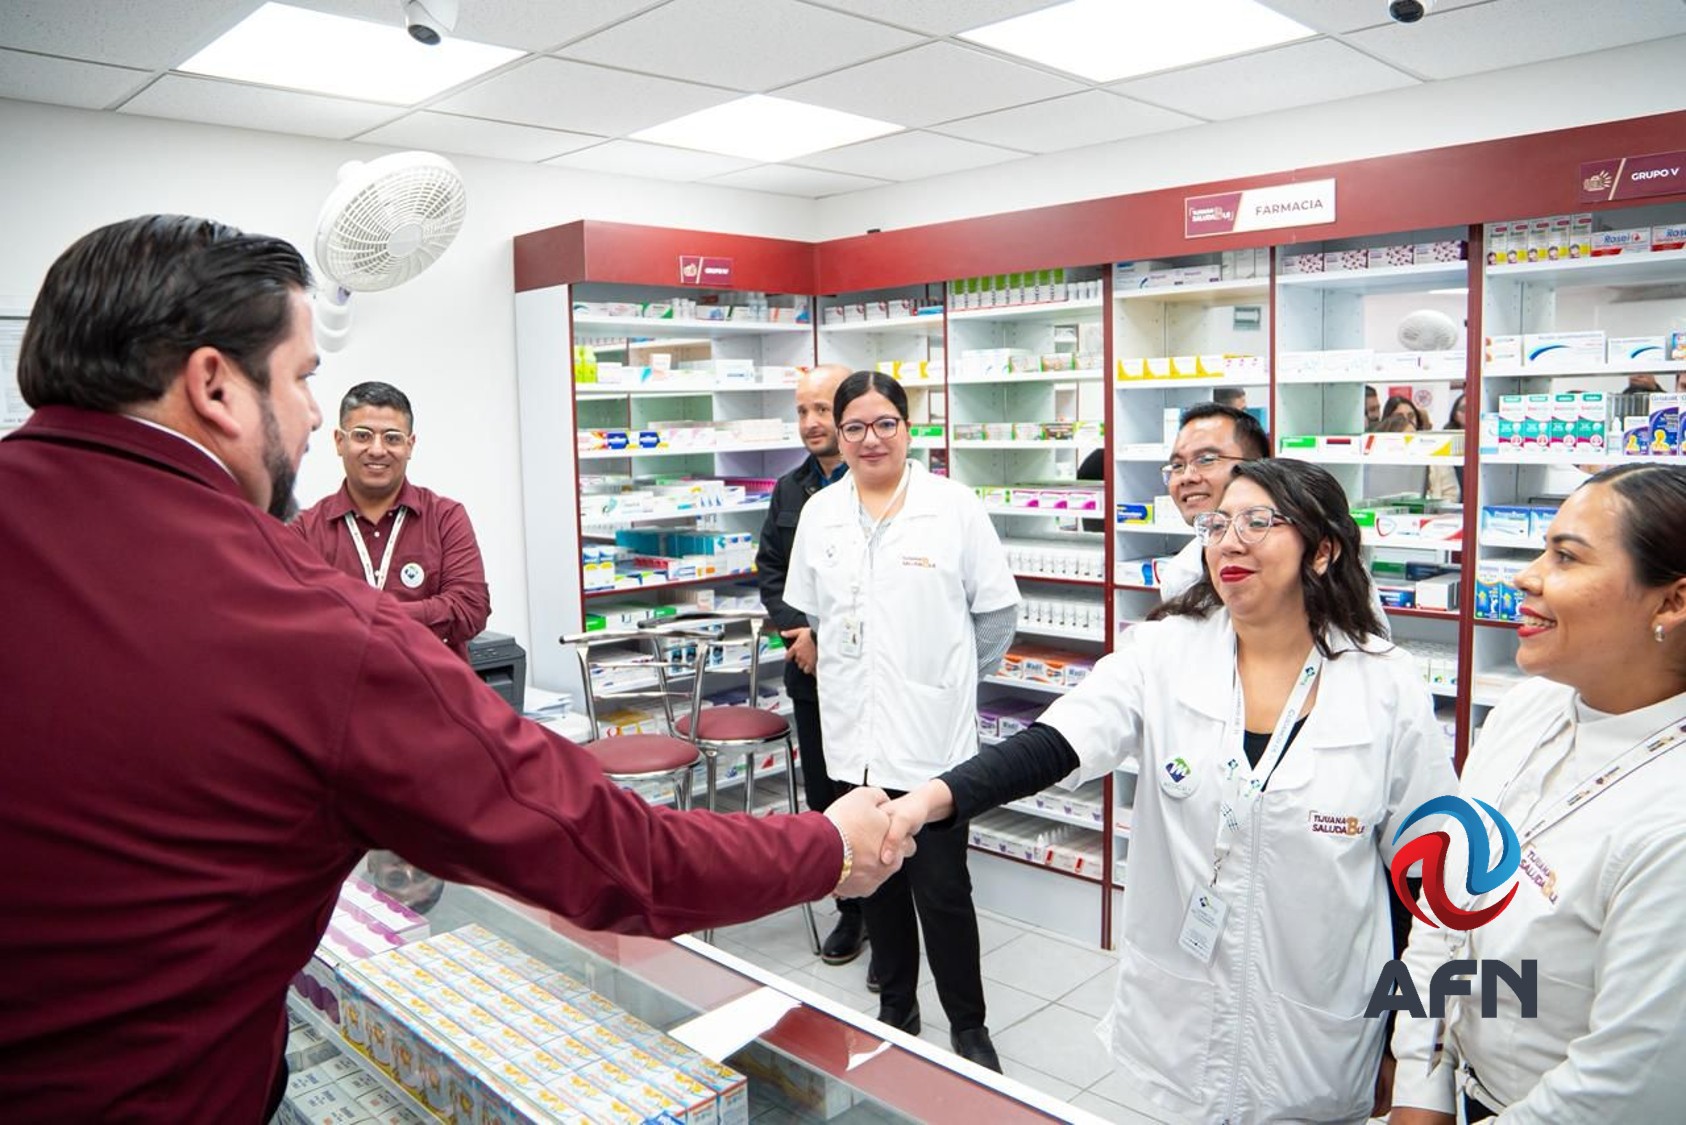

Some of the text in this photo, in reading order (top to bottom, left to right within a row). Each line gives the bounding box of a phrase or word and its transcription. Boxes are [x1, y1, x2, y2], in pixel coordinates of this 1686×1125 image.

[1631, 167, 1679, 180] GRUPO V
[1255, 198, 1323, 216] FARMACIA
[1313, 814, 1346, 824] TIJUANA
